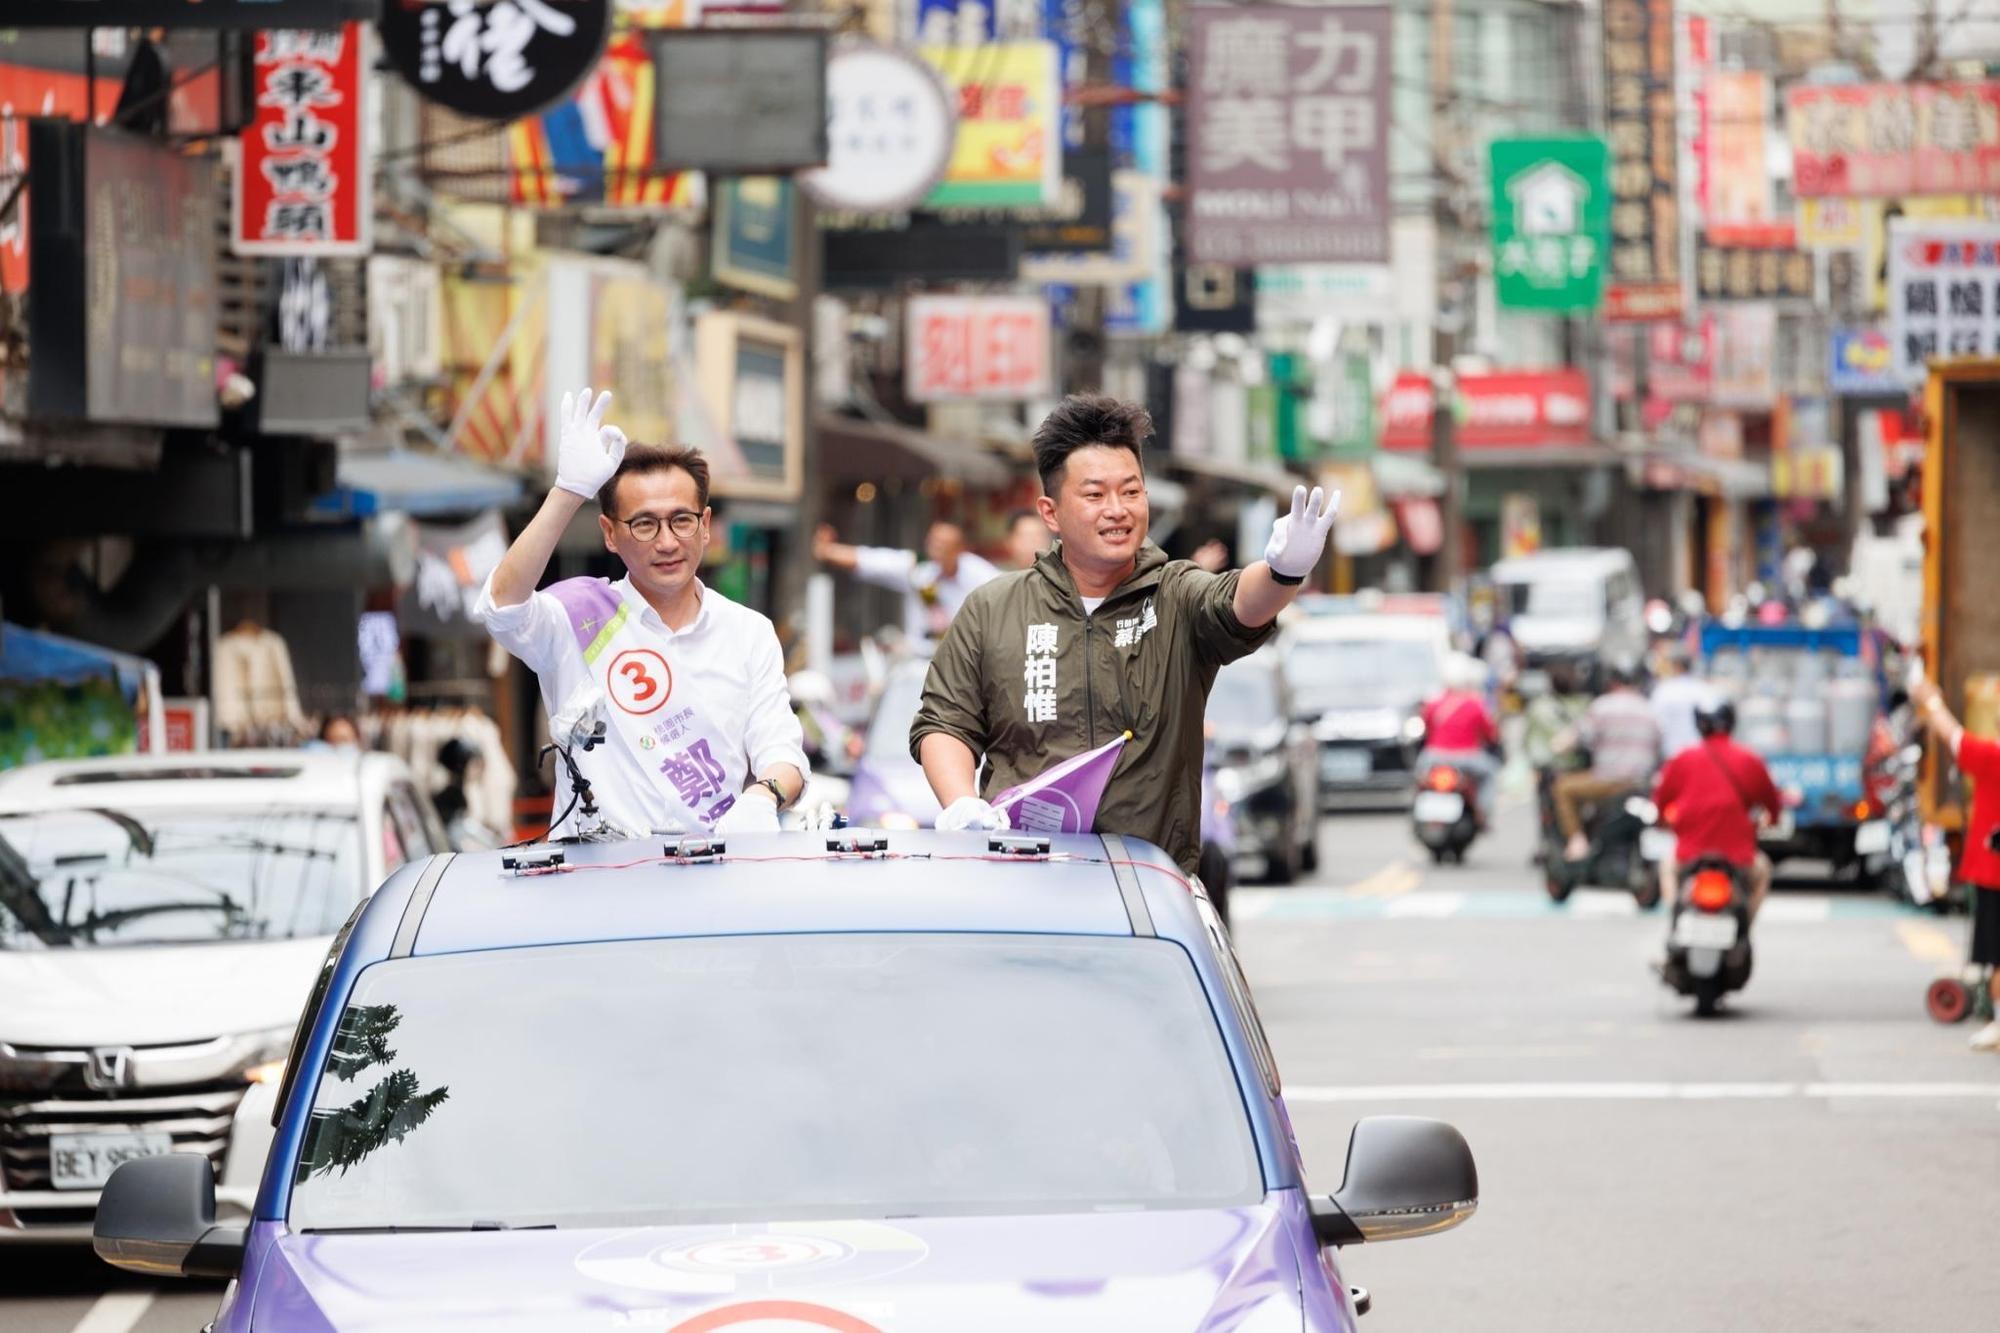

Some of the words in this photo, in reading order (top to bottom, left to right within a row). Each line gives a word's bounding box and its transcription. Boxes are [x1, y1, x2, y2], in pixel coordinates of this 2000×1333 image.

[1202, 16, 1377, 93] 魔力
[1199, 95, 1377, 172] 美甲
[921, 315, 1042, 391] 刻印
[620, 661, 657, 701] 3
[1024, 622, 1059, 722] 陳柏惟
[655, 706, 695, 734] 桃園市長
[660, 723, 691, 745] 候選人
